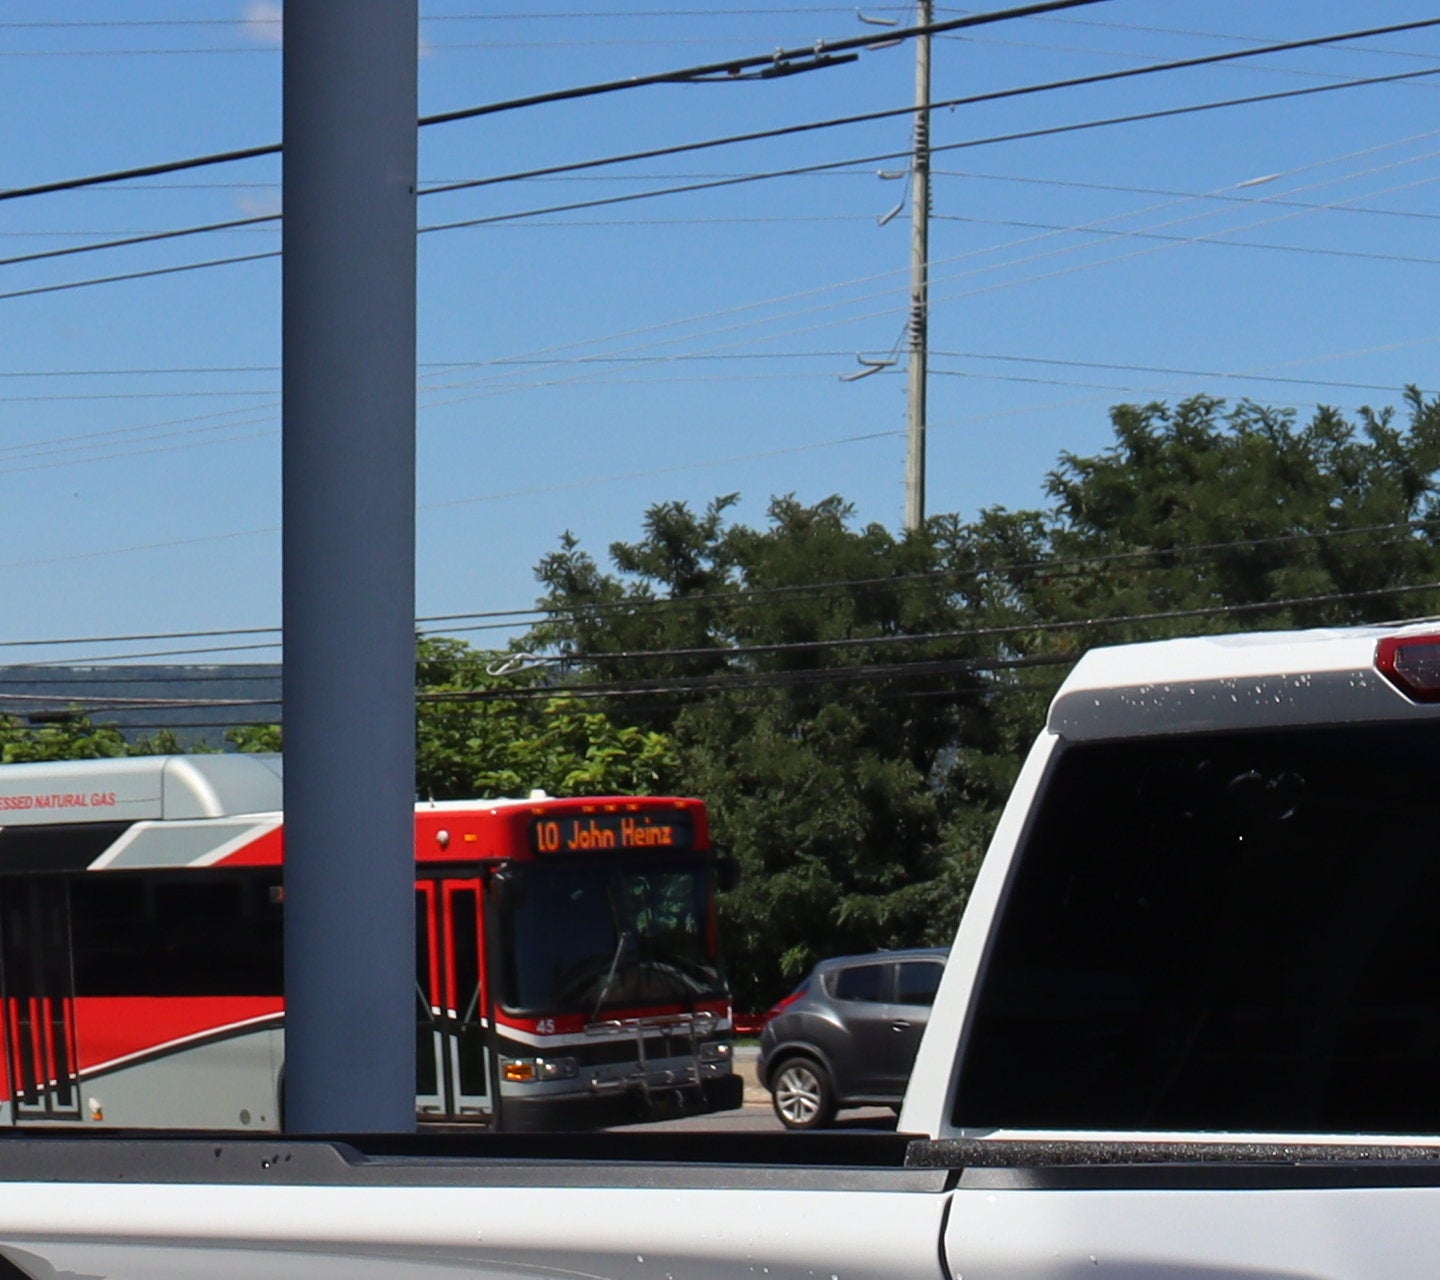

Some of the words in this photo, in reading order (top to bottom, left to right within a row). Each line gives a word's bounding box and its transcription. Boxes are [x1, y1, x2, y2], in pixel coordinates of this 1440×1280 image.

[35, 794, 88, 809] NATURAL
[91, 792, 116, 807] GAS
[536, 822, 559, 852] 10
[568, 820, 615, 850] John
[621, 817, 673, 847] Heinz
[536, 1019, 555, 1034] 45
